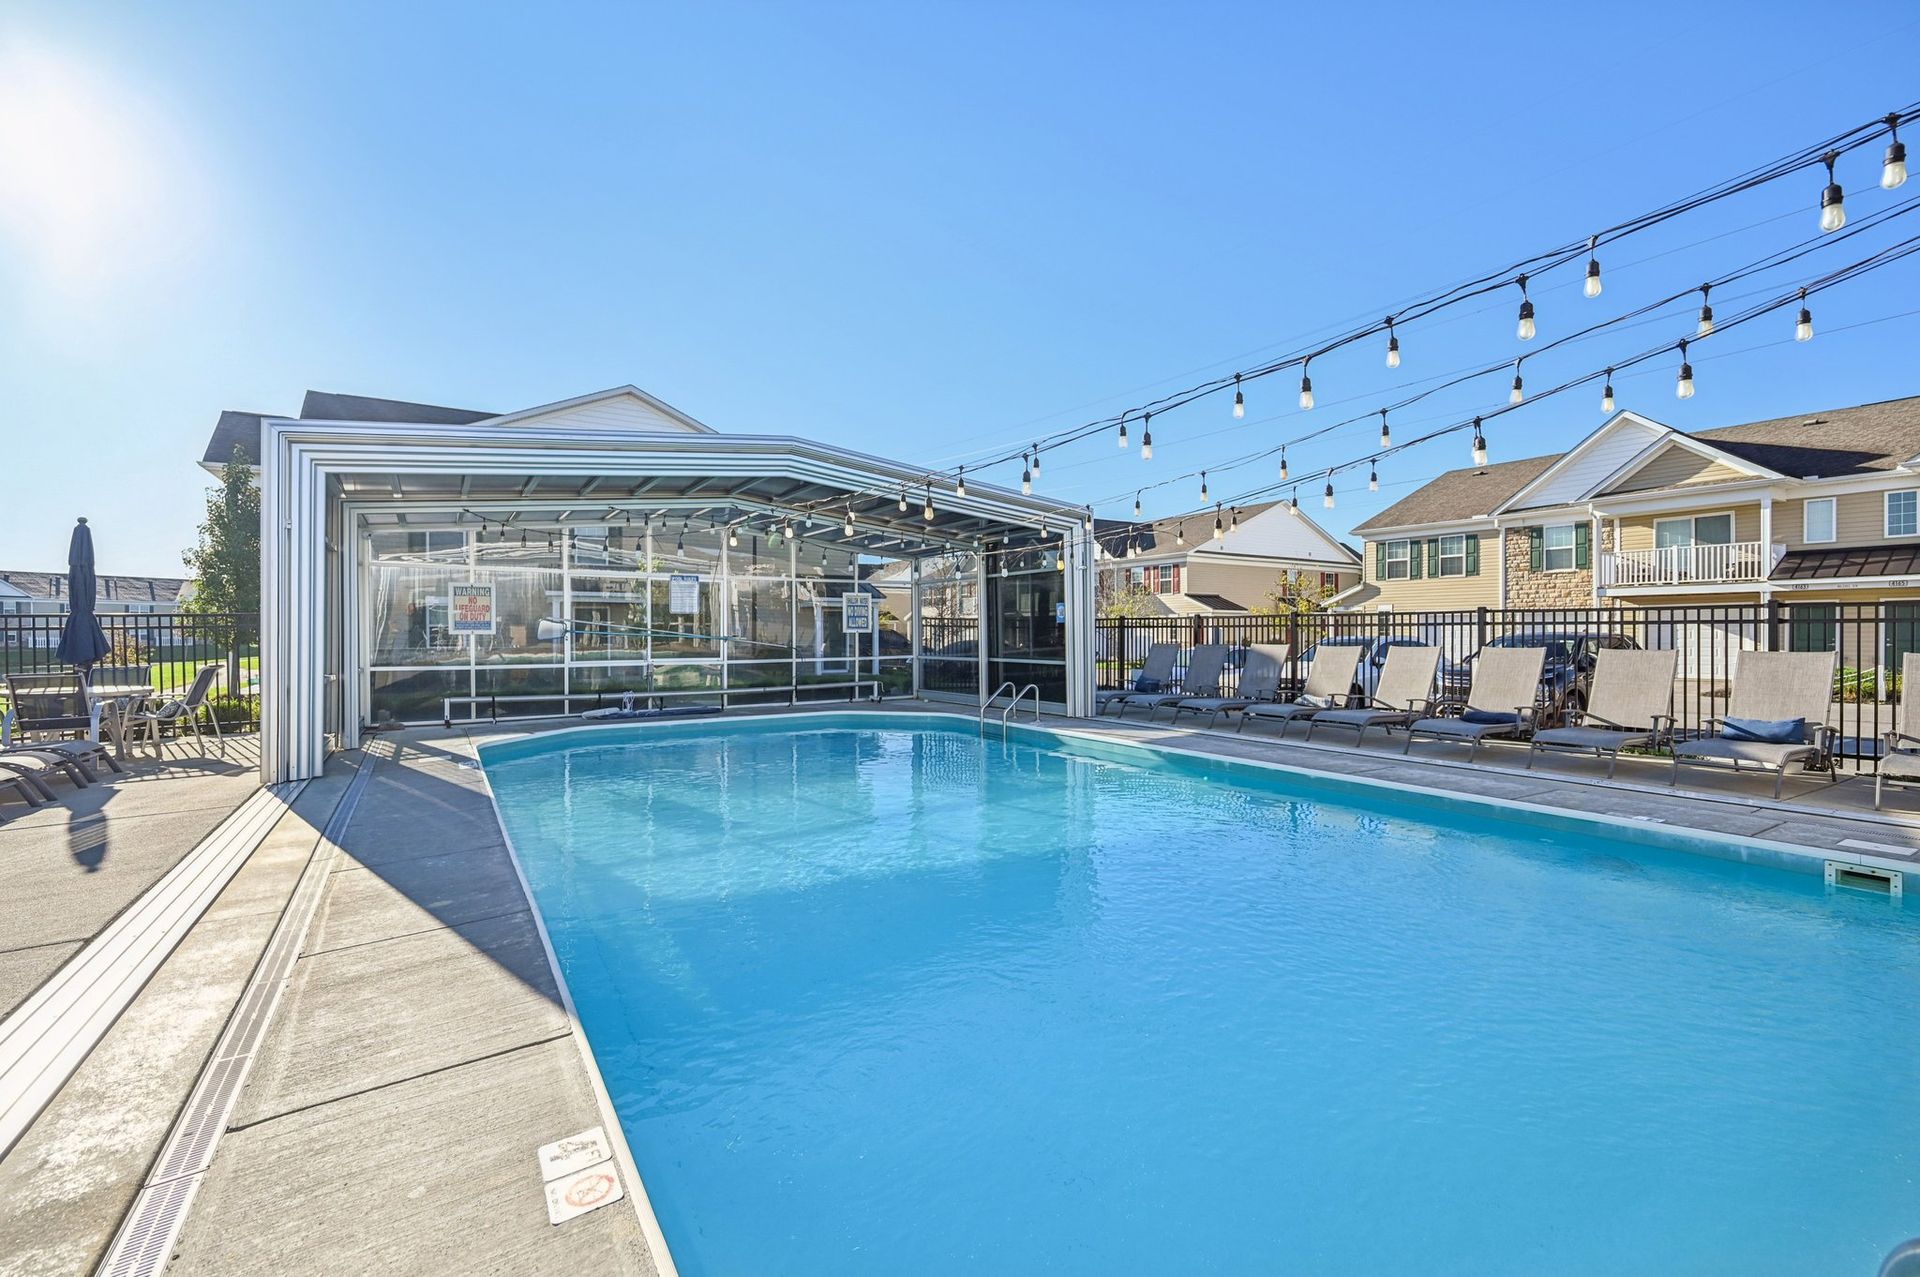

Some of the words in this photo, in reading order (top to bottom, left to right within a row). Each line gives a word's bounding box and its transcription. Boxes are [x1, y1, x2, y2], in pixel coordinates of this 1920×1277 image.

[455, 587, 491, 596] WARNING
[468, 597, 478, 605] NO
[455, 604, 491, 613] LIFEGUARD
[460, 612, 469, 620] ON
[469, 612, 487, 620] DUTY
